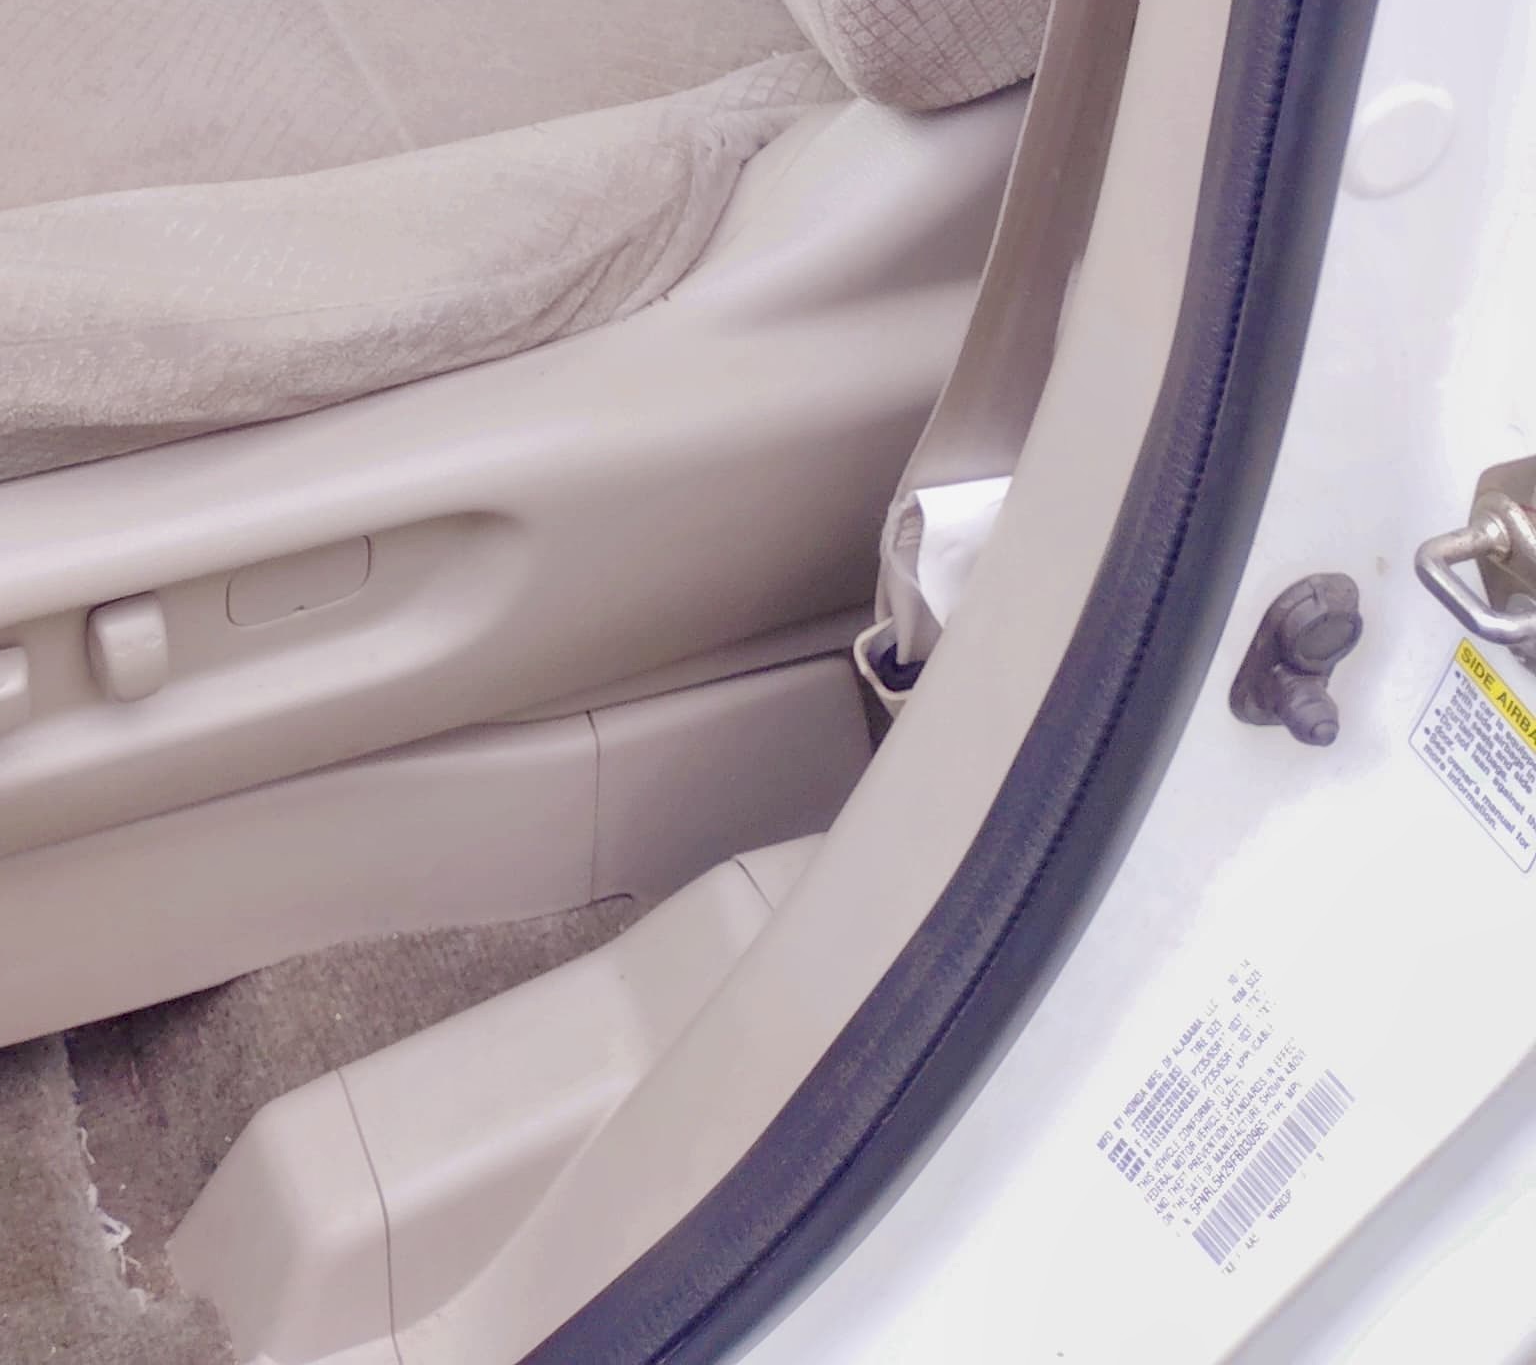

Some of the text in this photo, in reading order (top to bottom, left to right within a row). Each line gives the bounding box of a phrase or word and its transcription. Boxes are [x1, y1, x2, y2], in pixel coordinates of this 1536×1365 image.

[1459, 674, 1478, 701] This
[1479, 700, 1495, 719] car
[1495, 717, 1504, 732] is
[1461, 647, 1494, 689] SIDE
[1434, 725, 1454, 750] door.
[1439, 713, 1452, 731] Do
[1454, 732, 1470, 751] not
[1471, 750, 1490, 775] lean
[1492, 777, 1525, 815] against
[1445, 706, 1475, 742] curtain
[1450, 694, 1536, 794] front seats and side
[1454, 686, 1536, 783] with side airbags in
[1423, 743, 1496, 829] more information.
[1429, 732, 1530, 849] See owner's manual for
[1107, 1137, 1128, 1163] GVWR
[1189, 1036, 1208, 1053] TIRE
[1205, 1018, 1223, 1039] SIZE
[1244, 969, 1262, 989] SIZE
[1113, 1116, 1124, 1130] BY
[1123, 1088, 1148, 1117] HONDA
[1161, 1054, 1172, 1069] OF
[1116, 1147, 1137, 1173] GAWR
[1124, 1156, 1145, 1182] GAWR
[1136, 1170, 1155, 1189] THIS
[1154, 1140, 1180, 1173] VEHICLE
[1178, 1096, 1215, 1141] CONFORMS
[1212, 1084, 1225, 1095] TO
[1154, 1196, 1170, 1215] AND
[1167, 1170, 1186, 1195] THEFT
[1187, 1123, 1228, 1171] PREVENTION
[1226, 1076, 1267, 1125] STANDARDS
[1266, 1067, 1275, 1077] IN
[1171, 1140, 1196, 1170] MOTOR
[1195, 1108, 1223, 1142] VEHICLE
[1171, 1195, 1188, 1208] THE
[1185, 1174, 1205, 1197] DATE
[1202, 1162, 1213, 1176] OF
[1212, 1105, 1260, 1163] MANUFACTURE
[1258, 1075, 1285, 1106] SHOWN
[1190, 1119, 1268, 1215] 5FNRL5H29FB030965
